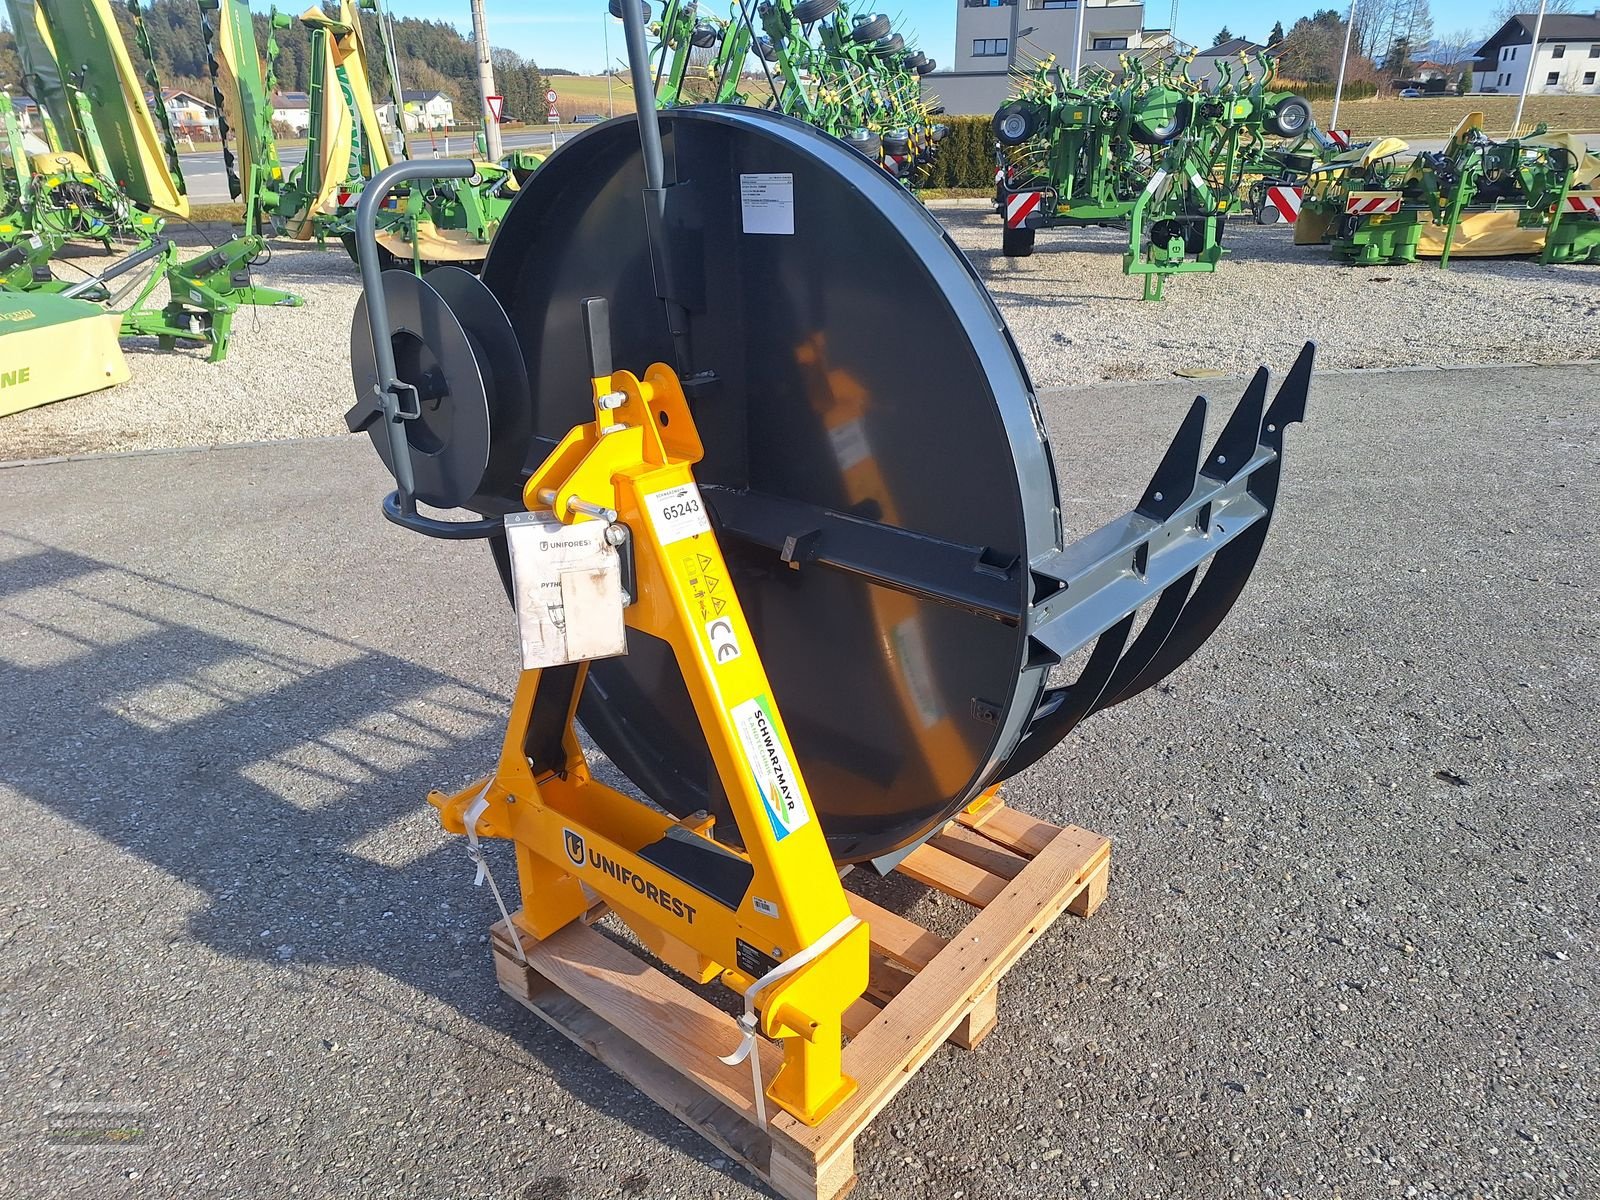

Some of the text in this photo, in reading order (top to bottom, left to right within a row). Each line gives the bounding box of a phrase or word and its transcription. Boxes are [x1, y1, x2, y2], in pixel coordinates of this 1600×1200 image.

[663, 499, 699, 520] 65243
[747, 716, 772, 776] LANDTECHNIK
[754, 709, 795, 811] SCHWARZMAYR
[588, 848, 697, 924] UNIFOREST
